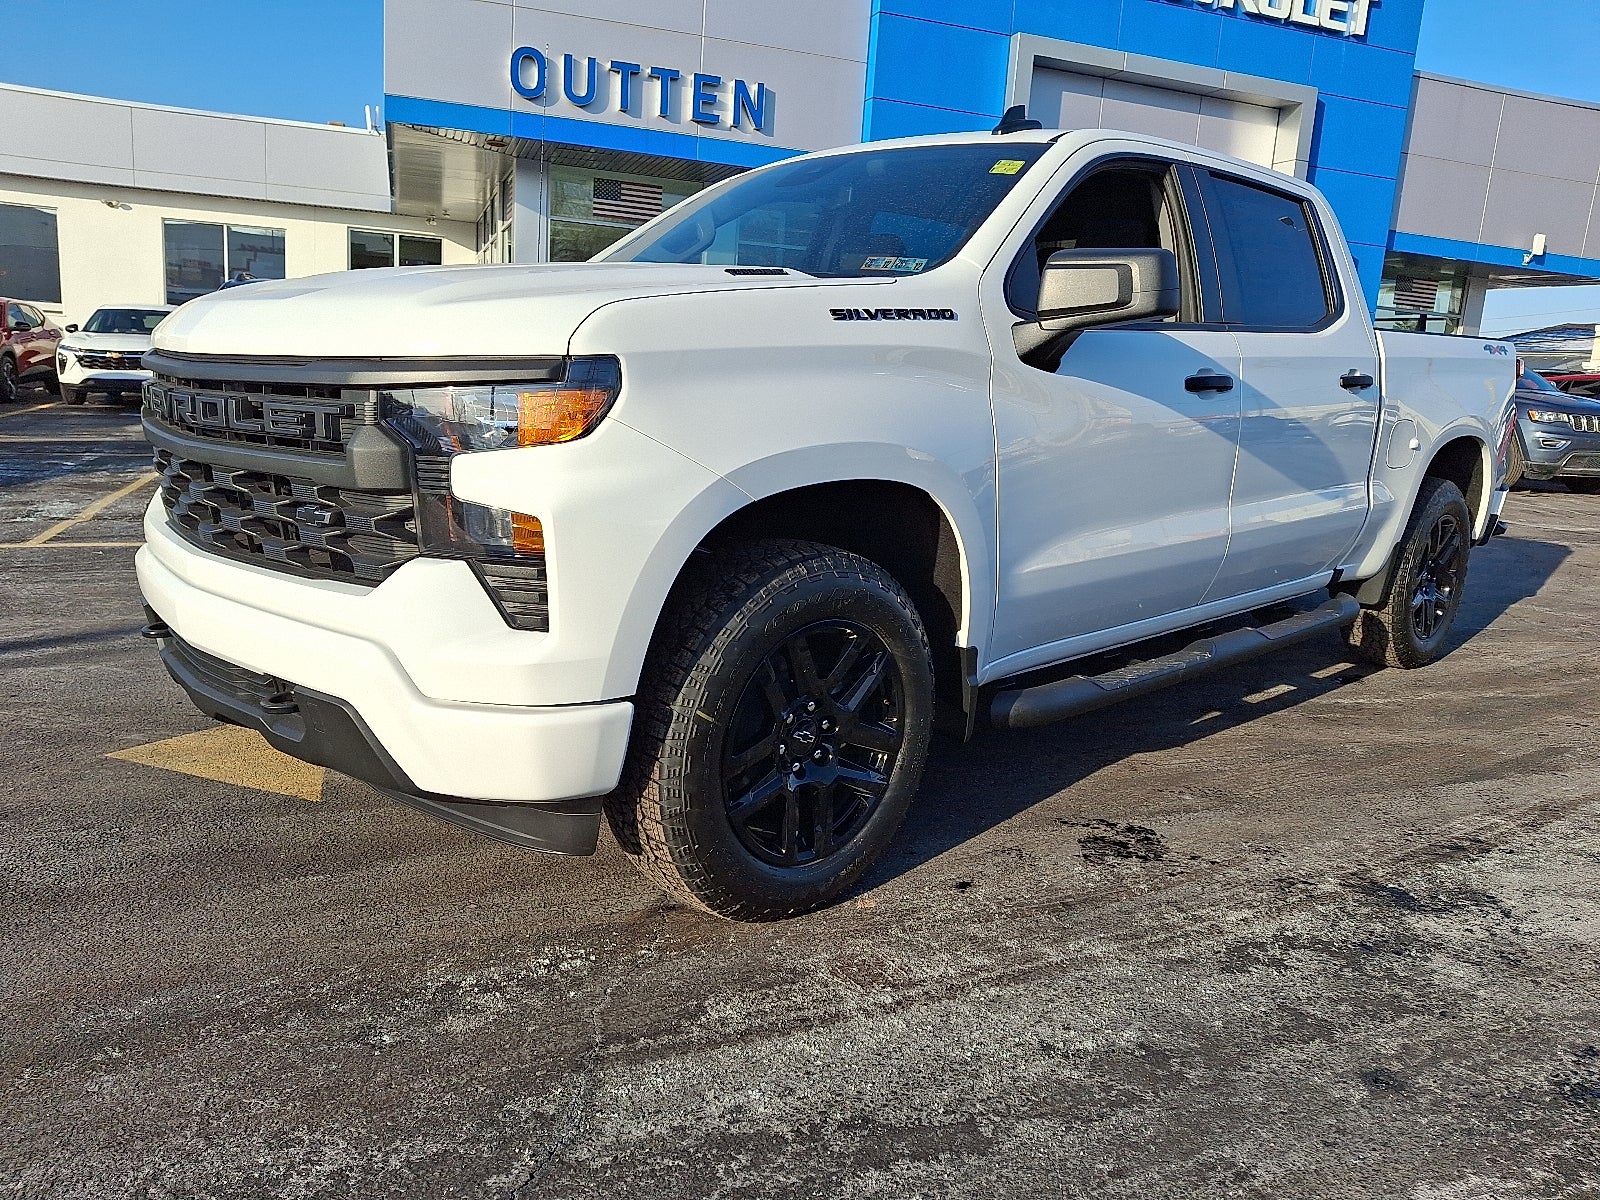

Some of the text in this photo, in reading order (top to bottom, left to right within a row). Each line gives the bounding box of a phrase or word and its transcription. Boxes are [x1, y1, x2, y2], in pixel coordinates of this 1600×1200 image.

[509, 46, 767, 131] OUTTEN
[912, 262, 924, 271] 12
[829, 308, 956, 321] SILVERADO
